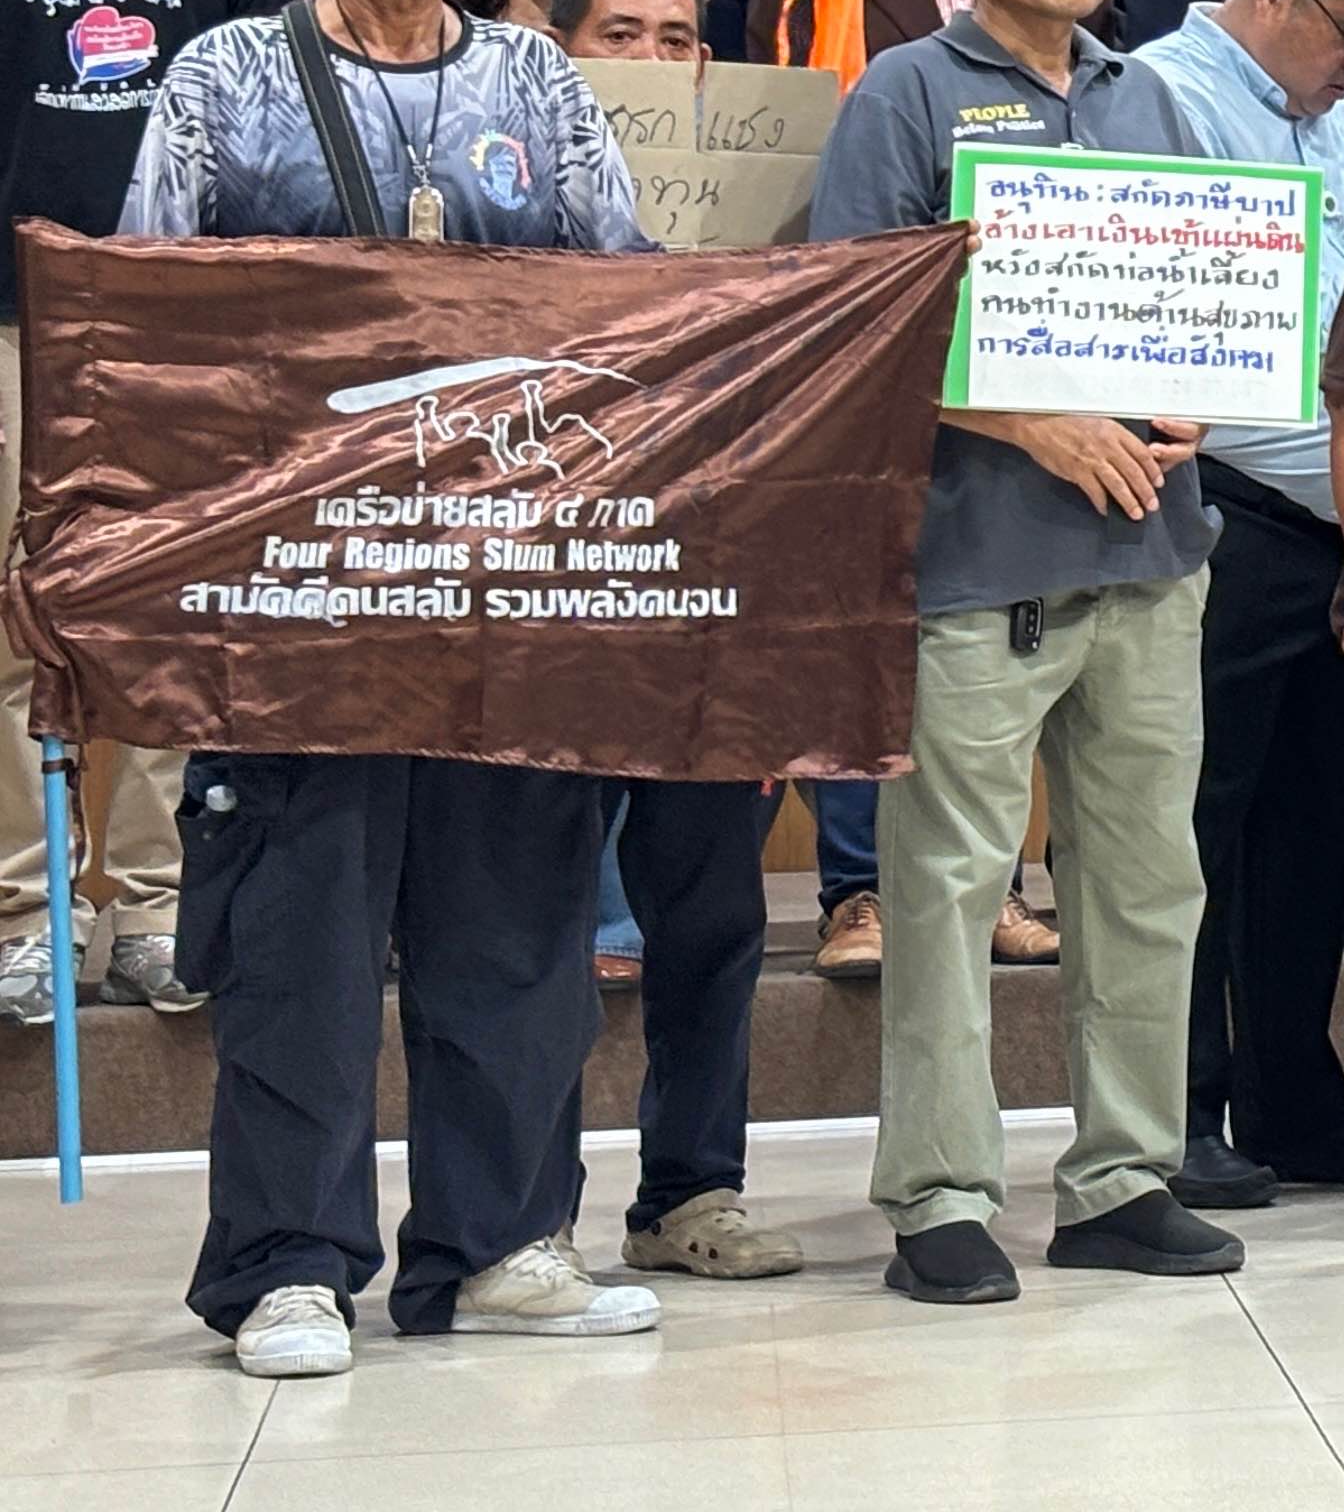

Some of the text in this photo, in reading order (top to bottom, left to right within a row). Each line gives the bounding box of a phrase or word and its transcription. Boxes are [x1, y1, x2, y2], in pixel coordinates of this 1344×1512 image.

[315, 483, 542, 529] เครือข่ายสลัม
[590, 495, 655, 528] ภาค
[263, 536, 681, 574] Four Regions Slum Network
[486, 580, 739, 619] รวมพลังคนจน
